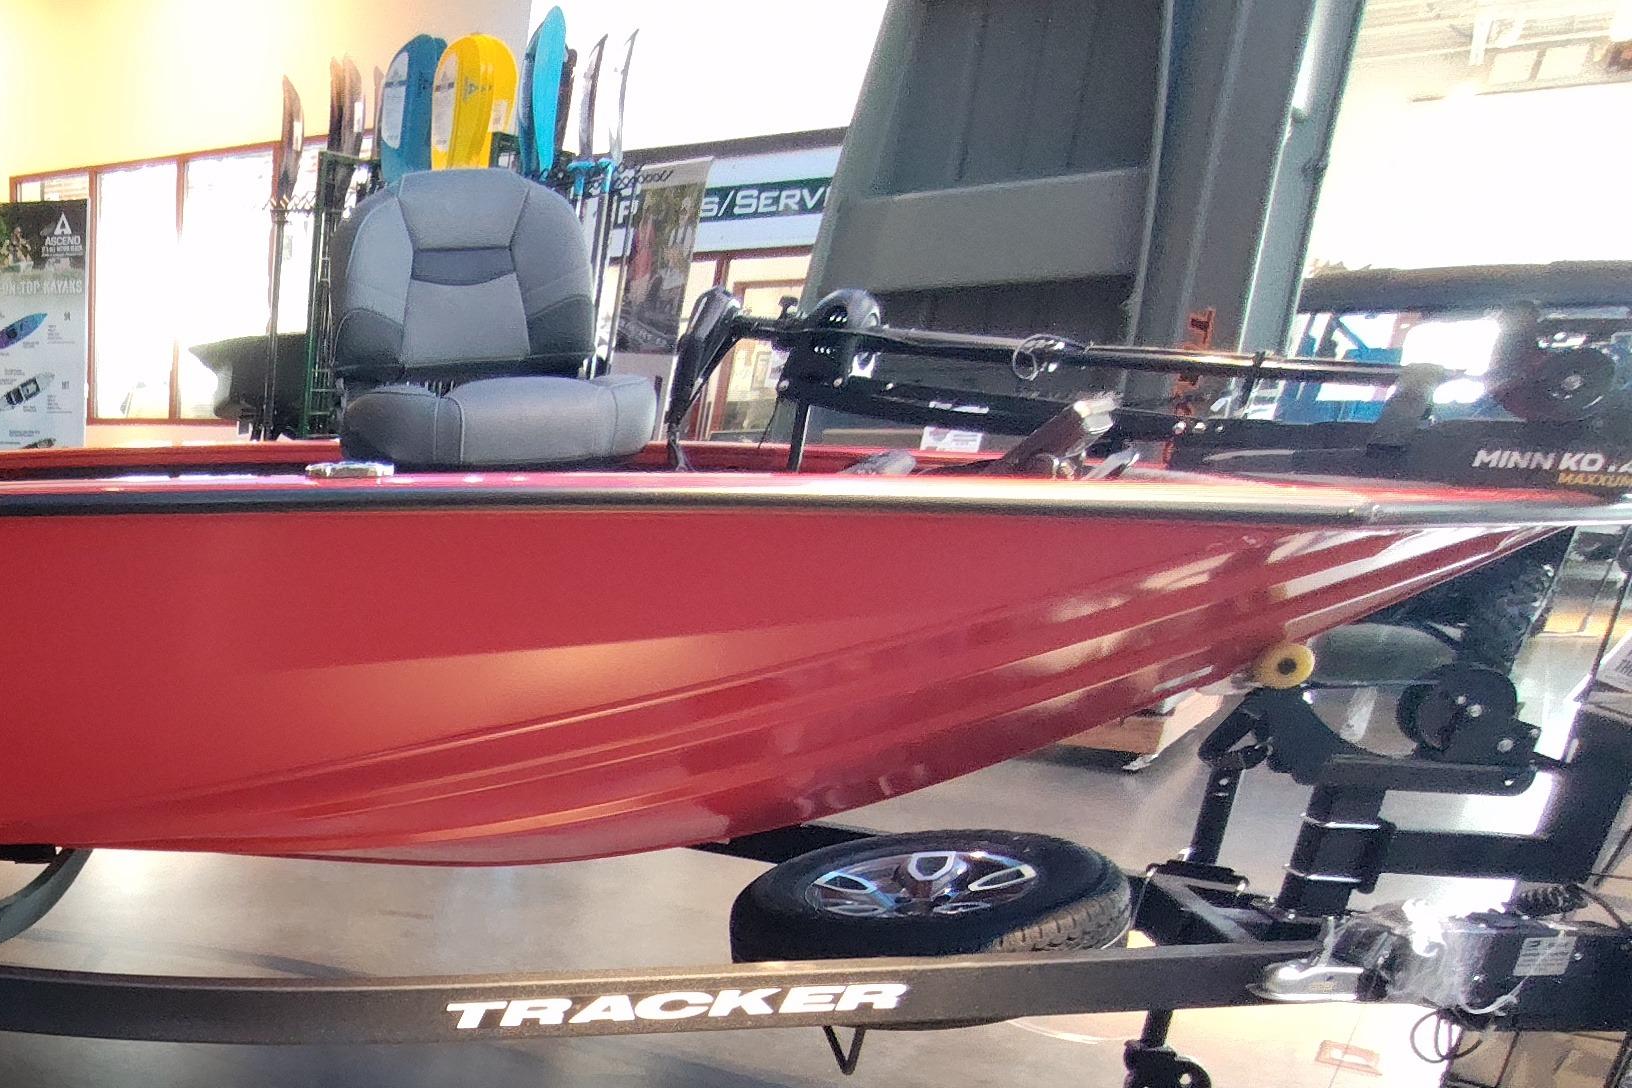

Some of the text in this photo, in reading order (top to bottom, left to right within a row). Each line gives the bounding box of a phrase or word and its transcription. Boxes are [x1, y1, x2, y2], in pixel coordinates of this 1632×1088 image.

[45, 235, 81, 247] ASCEND
[43, 279, 83, 296] KAYAKS
[1471, 449, 1632, 473] MINN KO
[445, 983, 911, 1030] TRACKER
